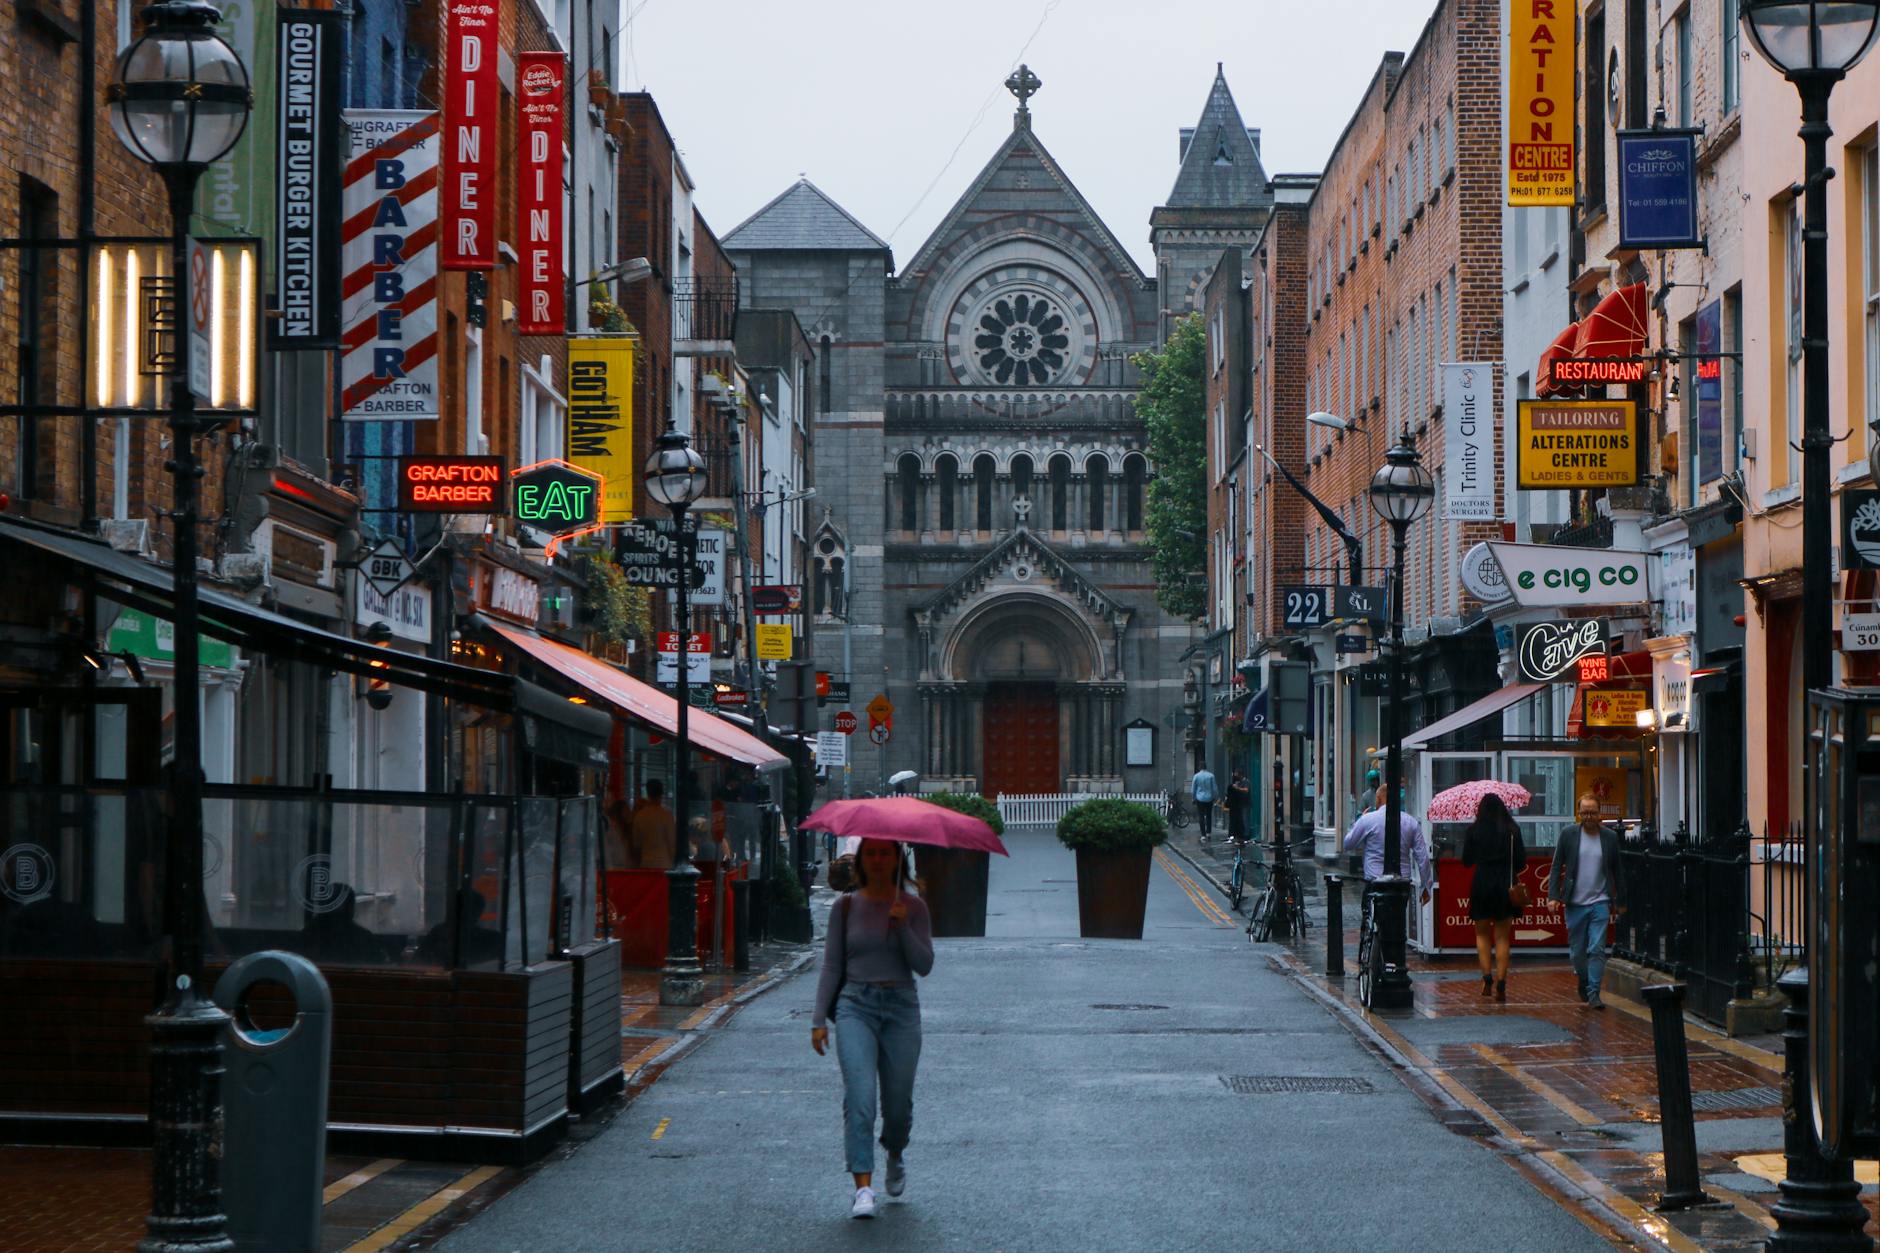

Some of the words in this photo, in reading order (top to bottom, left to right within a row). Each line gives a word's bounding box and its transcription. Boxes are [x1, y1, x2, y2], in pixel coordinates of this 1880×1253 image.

[289, 22, 313, 133] GOURMET
[458, 35, 481, 256] DINER
[1515, 146, 1568, 168] CENTRE
[1628, 161, 1685, 173] CHIFFON
[287, 140, 312, 230] BURGER
[1517, 172, 1539, 182] Estd
[1542, 173, 1566, 182] 1975
[530, 131, 550, 323] DINER
[373, 159, 407, 378] BARBER
[286, 236, 311, 336] KITCHEN
[1555, 362, 1643, 380] RESTAURANT
[364, 401, 424, 412] BARBER
[571, 361, 625, 456] GOTHAM
[1460, 394, 1476, 437] Clinic
[1538, 411, 1620, 426] TAILORING
[1531, 435, 1629, 449] ALTERATIONS
[1461, 442, 1479, 493] Trinity
[1552, 453, 1608, 468] CENTRE
[407, 465, 499, 481] GRAFTON
[1531, 471, 1573, 481] LADIES
[1576, 472, 1585, 481] &
[1589, 471, 1629, 481] GENTS
[413, 486, 492, 501] BARBER
[518, 481, 591, 520] EAT
[371, 560, 402, 577] GBK
[1517, 569, 1535, 589] e
[1543, 567, 1591, 593] cig
[1598, 565, 1639, 586] co
[1286, 592, 1321, 624] 22
[1560, 623, 1574, 633] LA
[1520, 620, 1600, 680] Cave
[1579, 658, 1607, 668] WINE
[1581, 669, 1608, 680] BAR
[835, 719, 857, 728] STOP
[1253, 714, 1265, 728] 2
[1536, 916, 1562, 926] BAR
